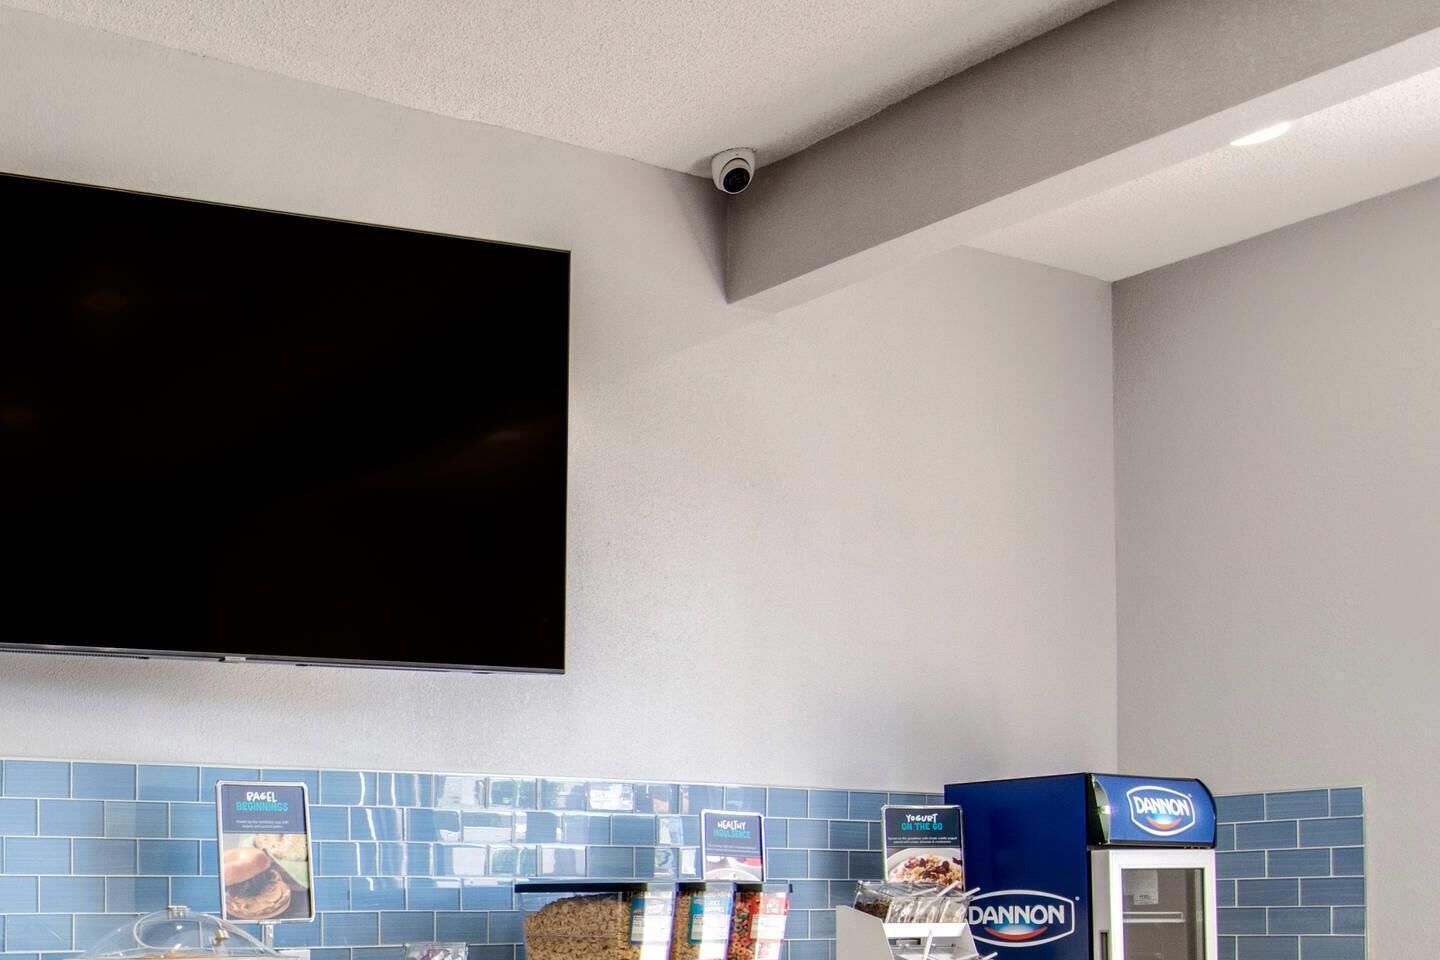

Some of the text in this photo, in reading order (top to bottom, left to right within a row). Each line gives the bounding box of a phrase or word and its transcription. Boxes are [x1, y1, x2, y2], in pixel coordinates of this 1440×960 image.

[246, 791, 278, 803] BAGEL
[236, 801, 289, 811] BEGINNINGS
[1133, 796, 1190, 817] DANNON
[905, 813, 939, 823] YOGURT
[717, 819, 746, 830] HEALTHY
[901, 822, 943, 831] ON THE GO
[968, 904, 1065, 925] DANNON
